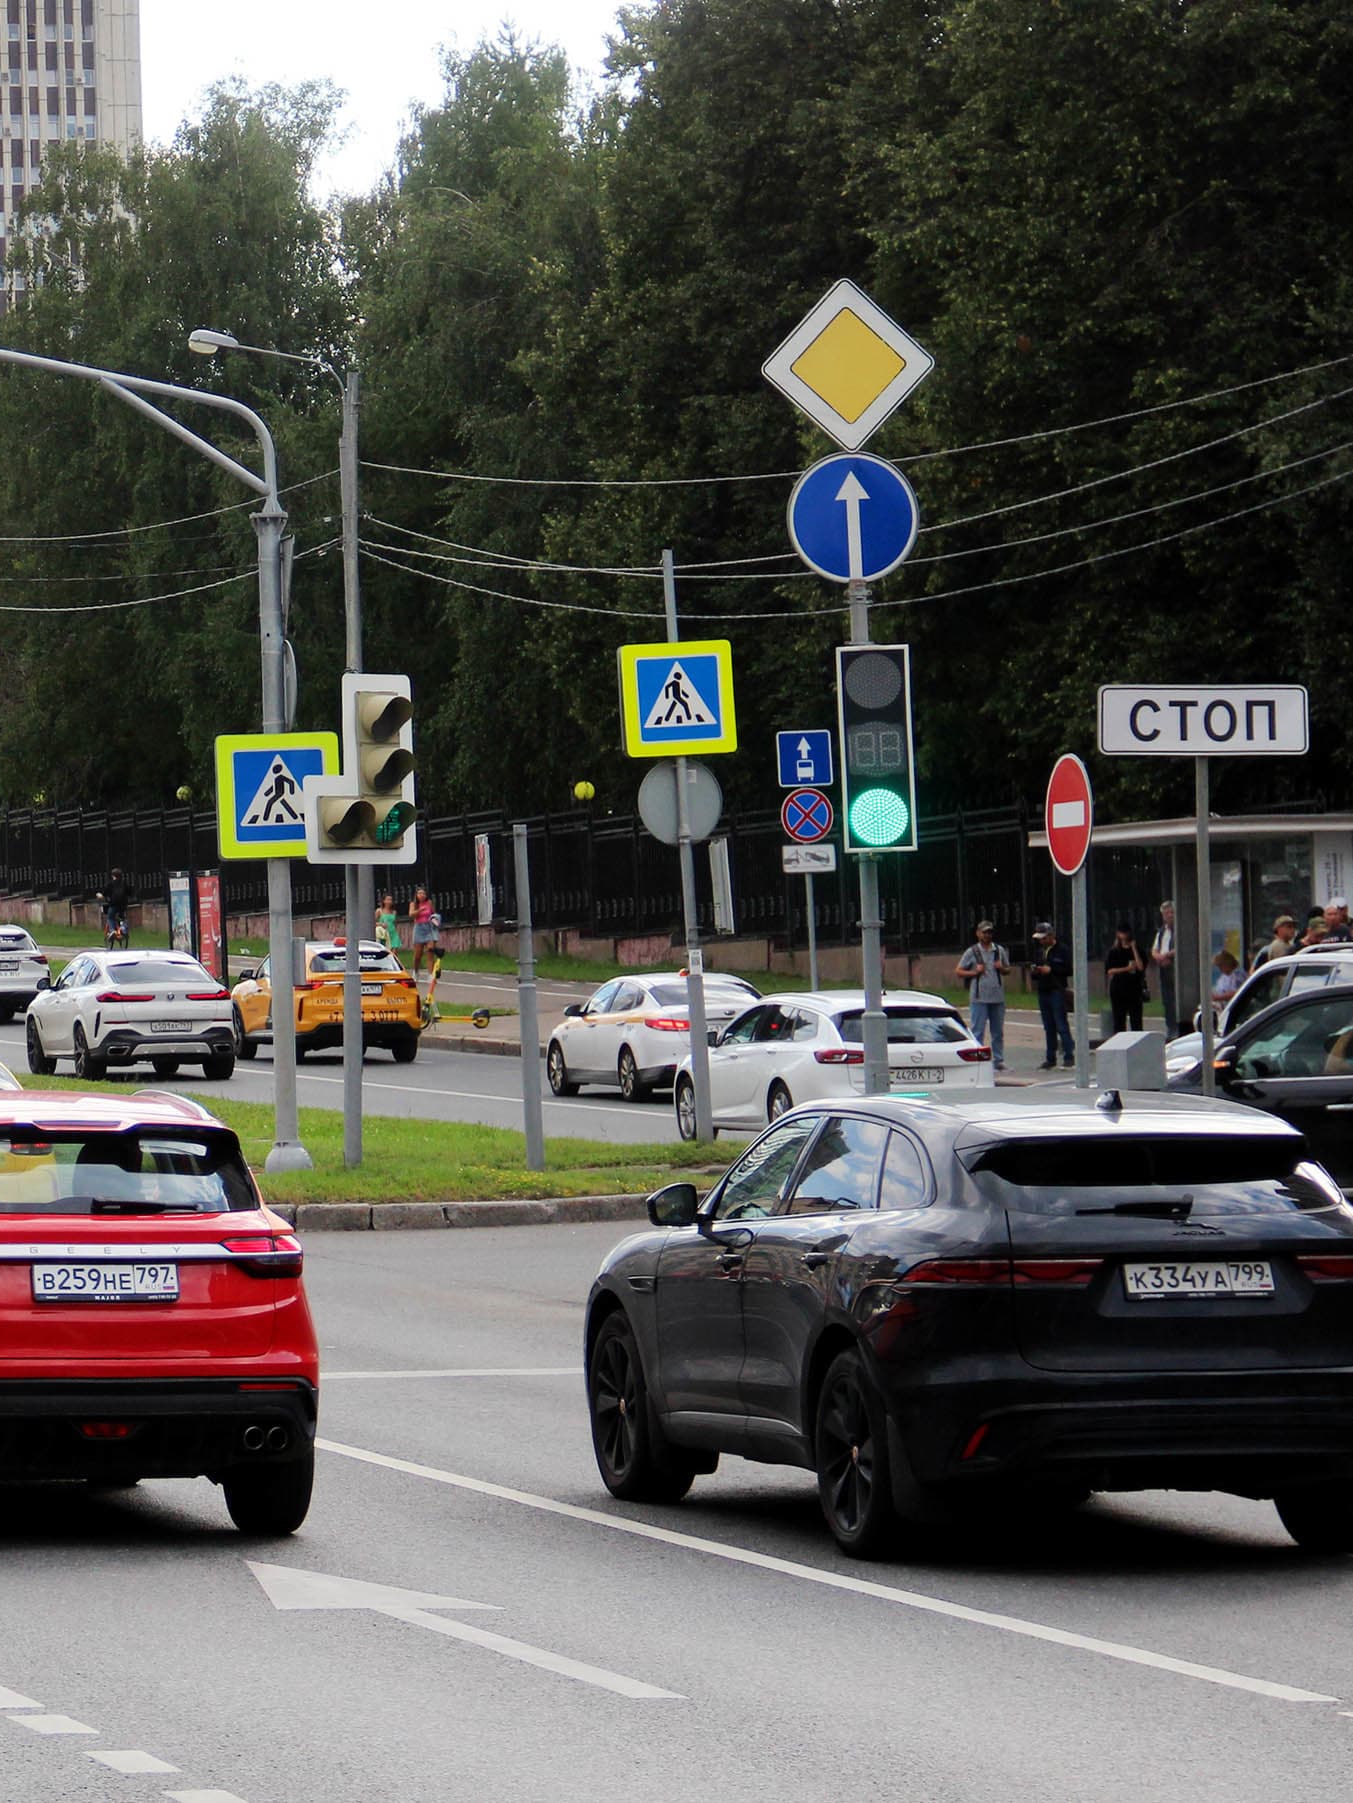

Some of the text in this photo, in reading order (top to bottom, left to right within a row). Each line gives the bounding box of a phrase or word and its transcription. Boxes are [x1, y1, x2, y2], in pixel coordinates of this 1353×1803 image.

[1129, 699, 1277, 742] СТОП
[29, 1246, 181, 1255] GEELY
[42, 1266, 170, 1291] В259НЕ 797
[1134, 1264, 1265, 1289] К334УА 799
